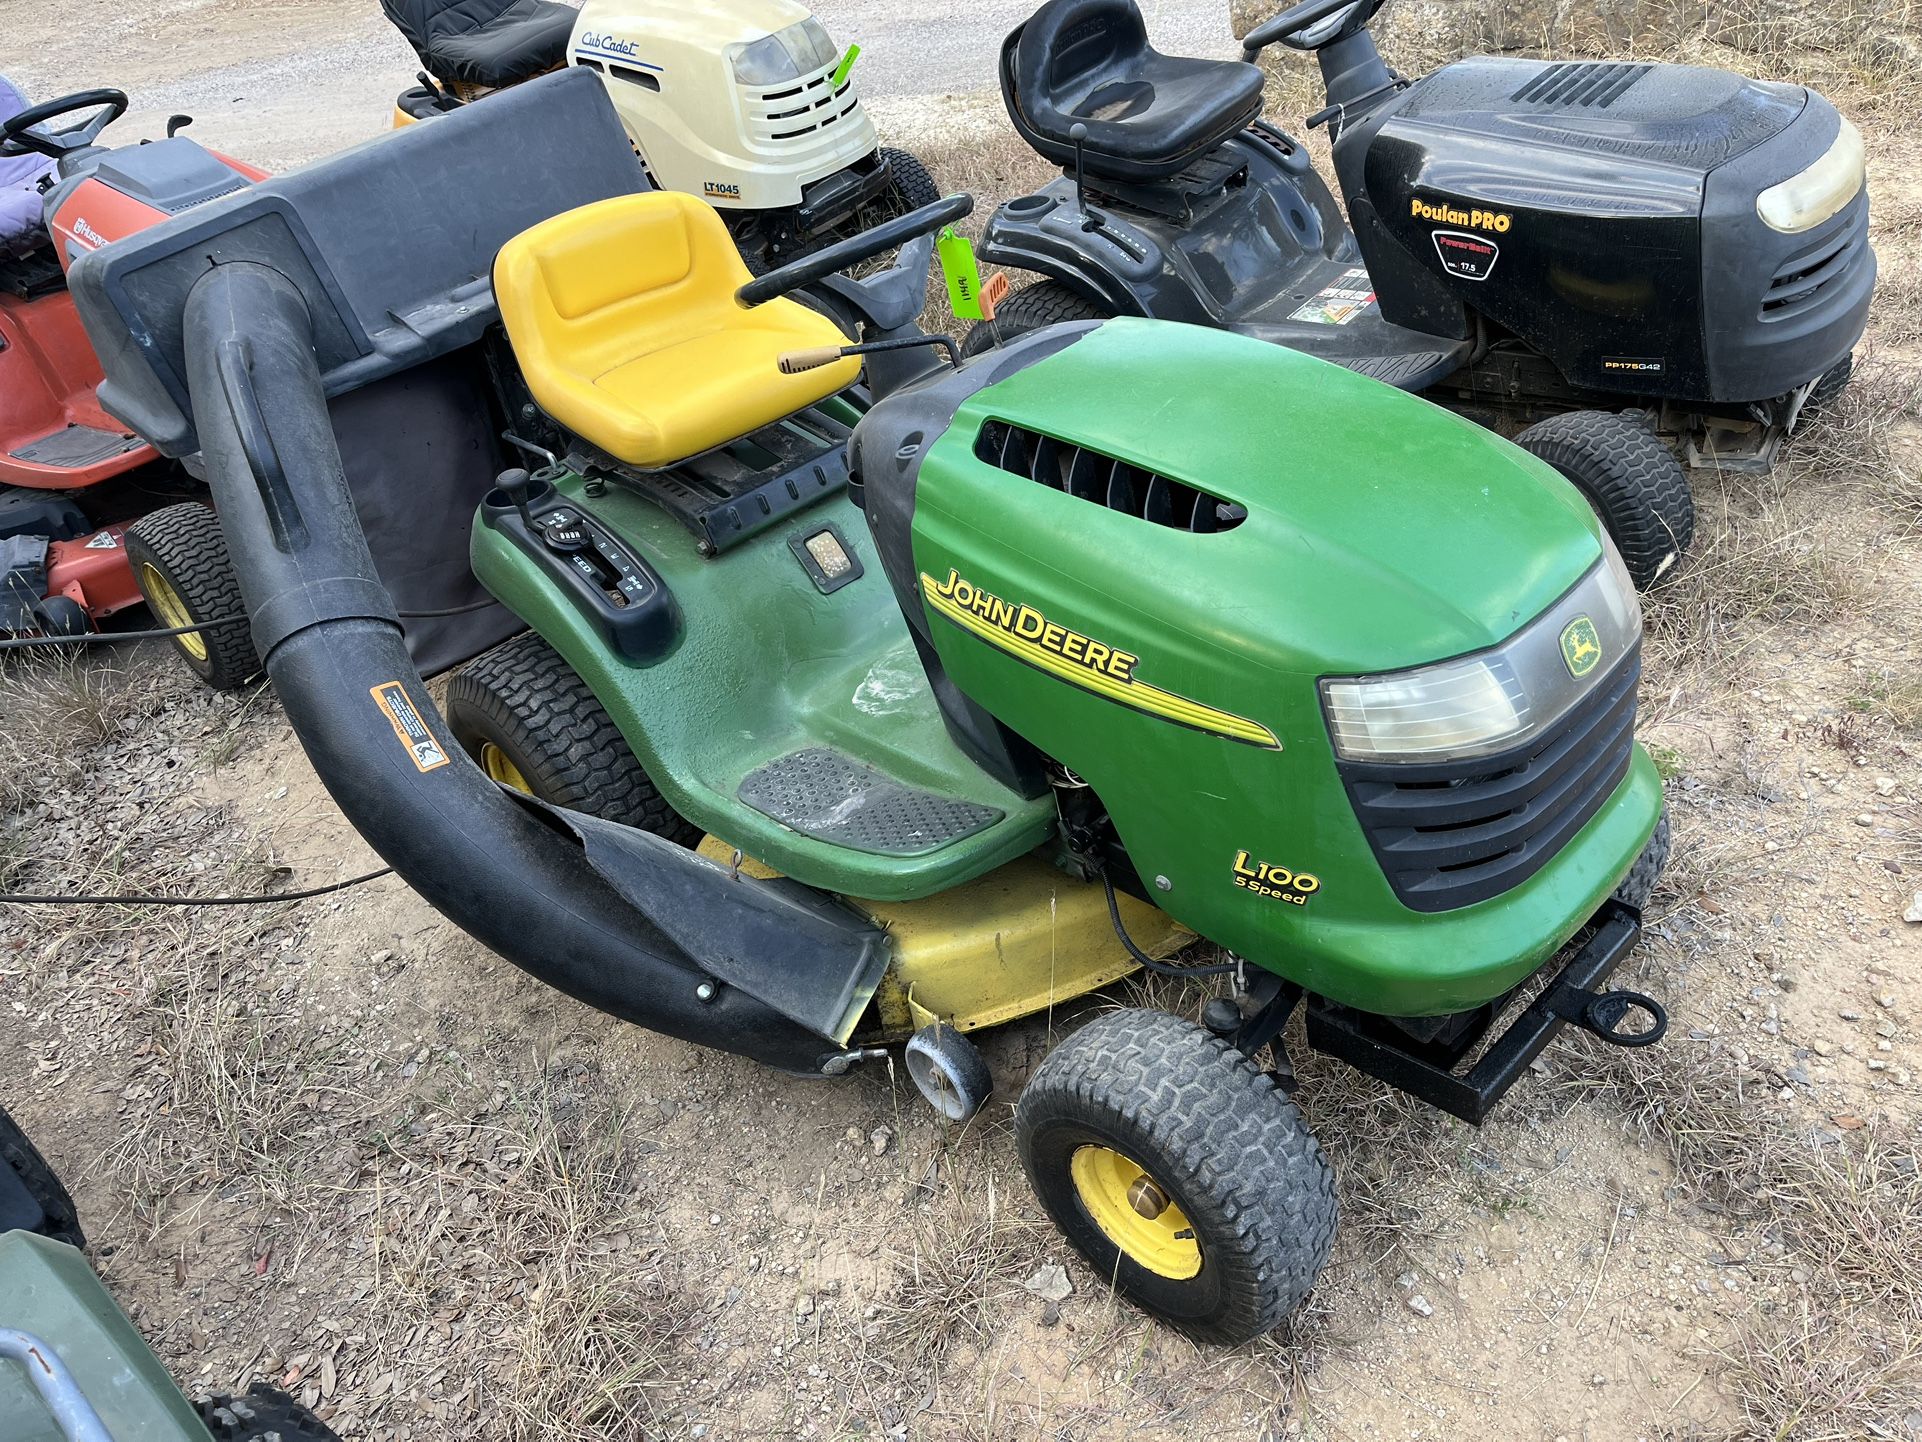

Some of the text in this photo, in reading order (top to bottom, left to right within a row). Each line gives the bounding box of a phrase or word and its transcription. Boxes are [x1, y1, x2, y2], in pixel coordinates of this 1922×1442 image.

[581, 31, 640, 56] Cub Cadet
[1411, 199, 1511, 232] Poulan PRO
[1460, 261, 1477, 272] 17.5
[1604, 361, 1661, 371] PP175G42
[935, 570, 1138, 683] JOHN DEERE
[1233, 851, 1319, 892] L100
